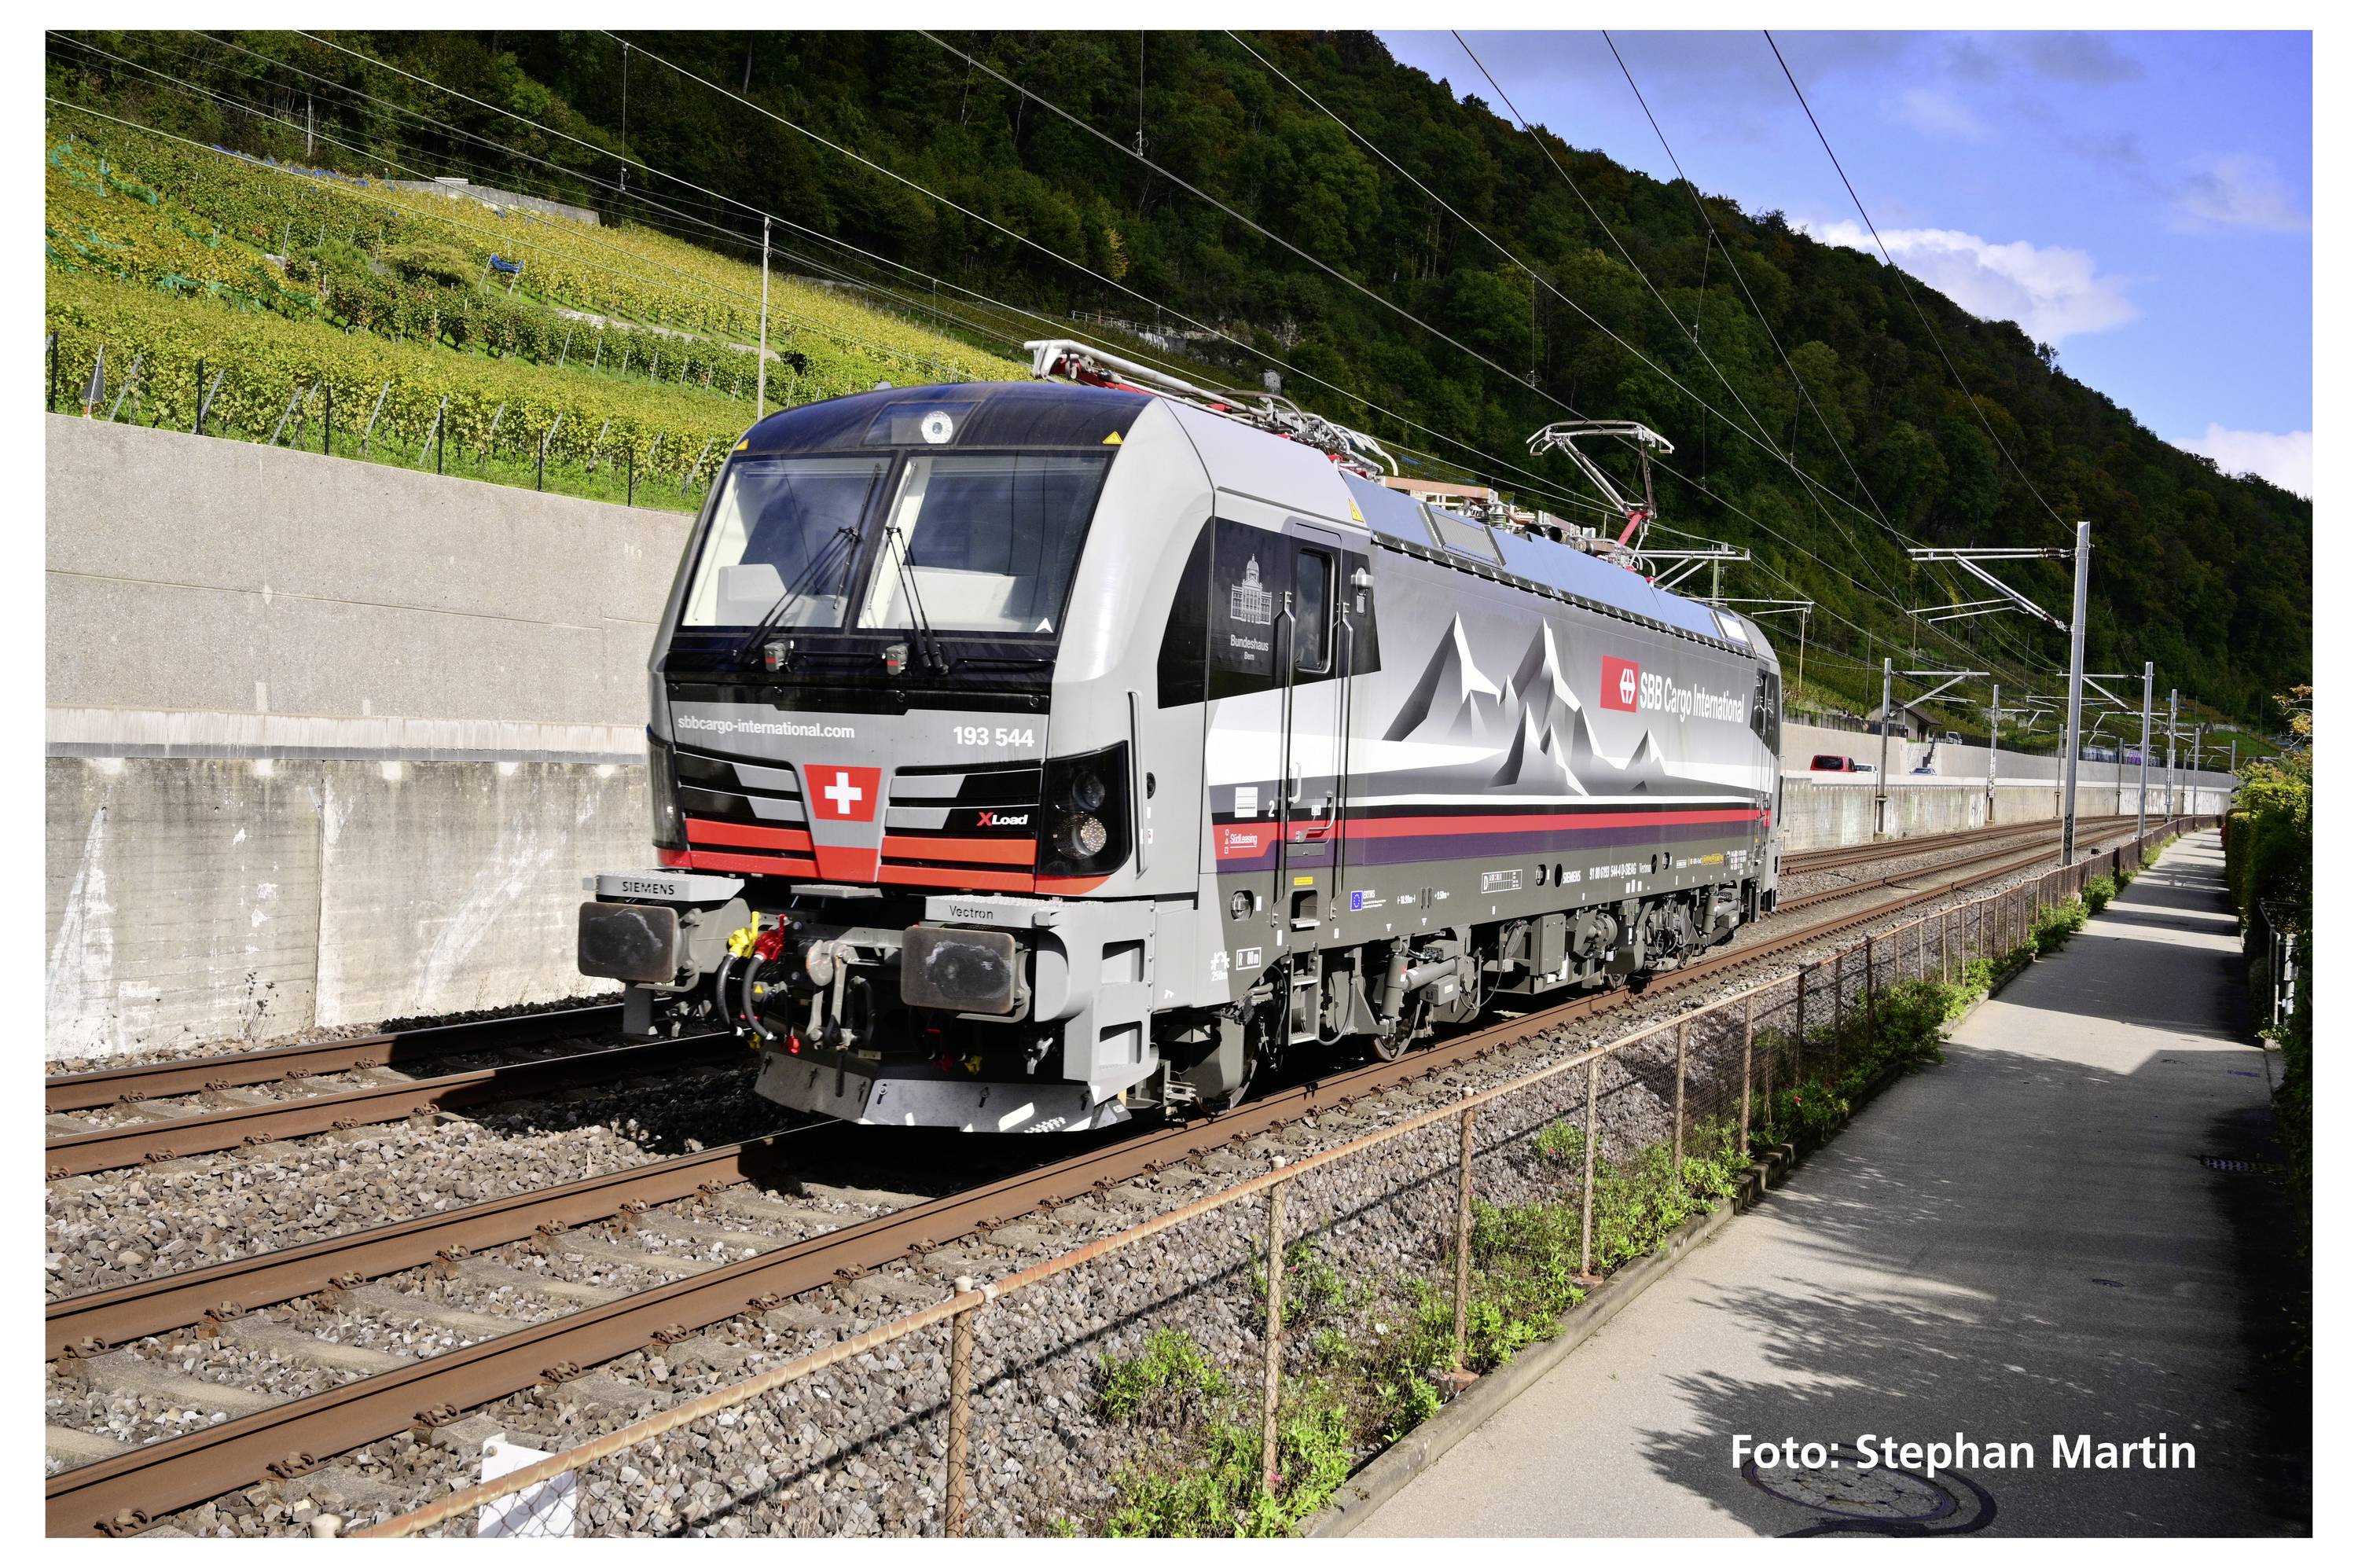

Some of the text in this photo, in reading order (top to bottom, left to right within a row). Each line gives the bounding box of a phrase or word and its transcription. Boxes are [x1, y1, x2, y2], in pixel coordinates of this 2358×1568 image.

[1230, 633, 1269, 652] Bundeshaus
[1243, 651, 1255, 661] Bern
[1640, 671, 1745, 724] SBB Cargo International
[678, 715, 855, 739] sbbcargo-international.com
[953, 725, 1035, 747] 193 544
[1268, 799, 1275, 817] 2
[976, 811, 1029, 827] XLoad
[1562, 870, 1581, 884] SIEMENS
[622, 881, 675, 895] SIEMENS
[949, 905, 994, 920] Vectron
[1238, 952, 1243, 967] R
